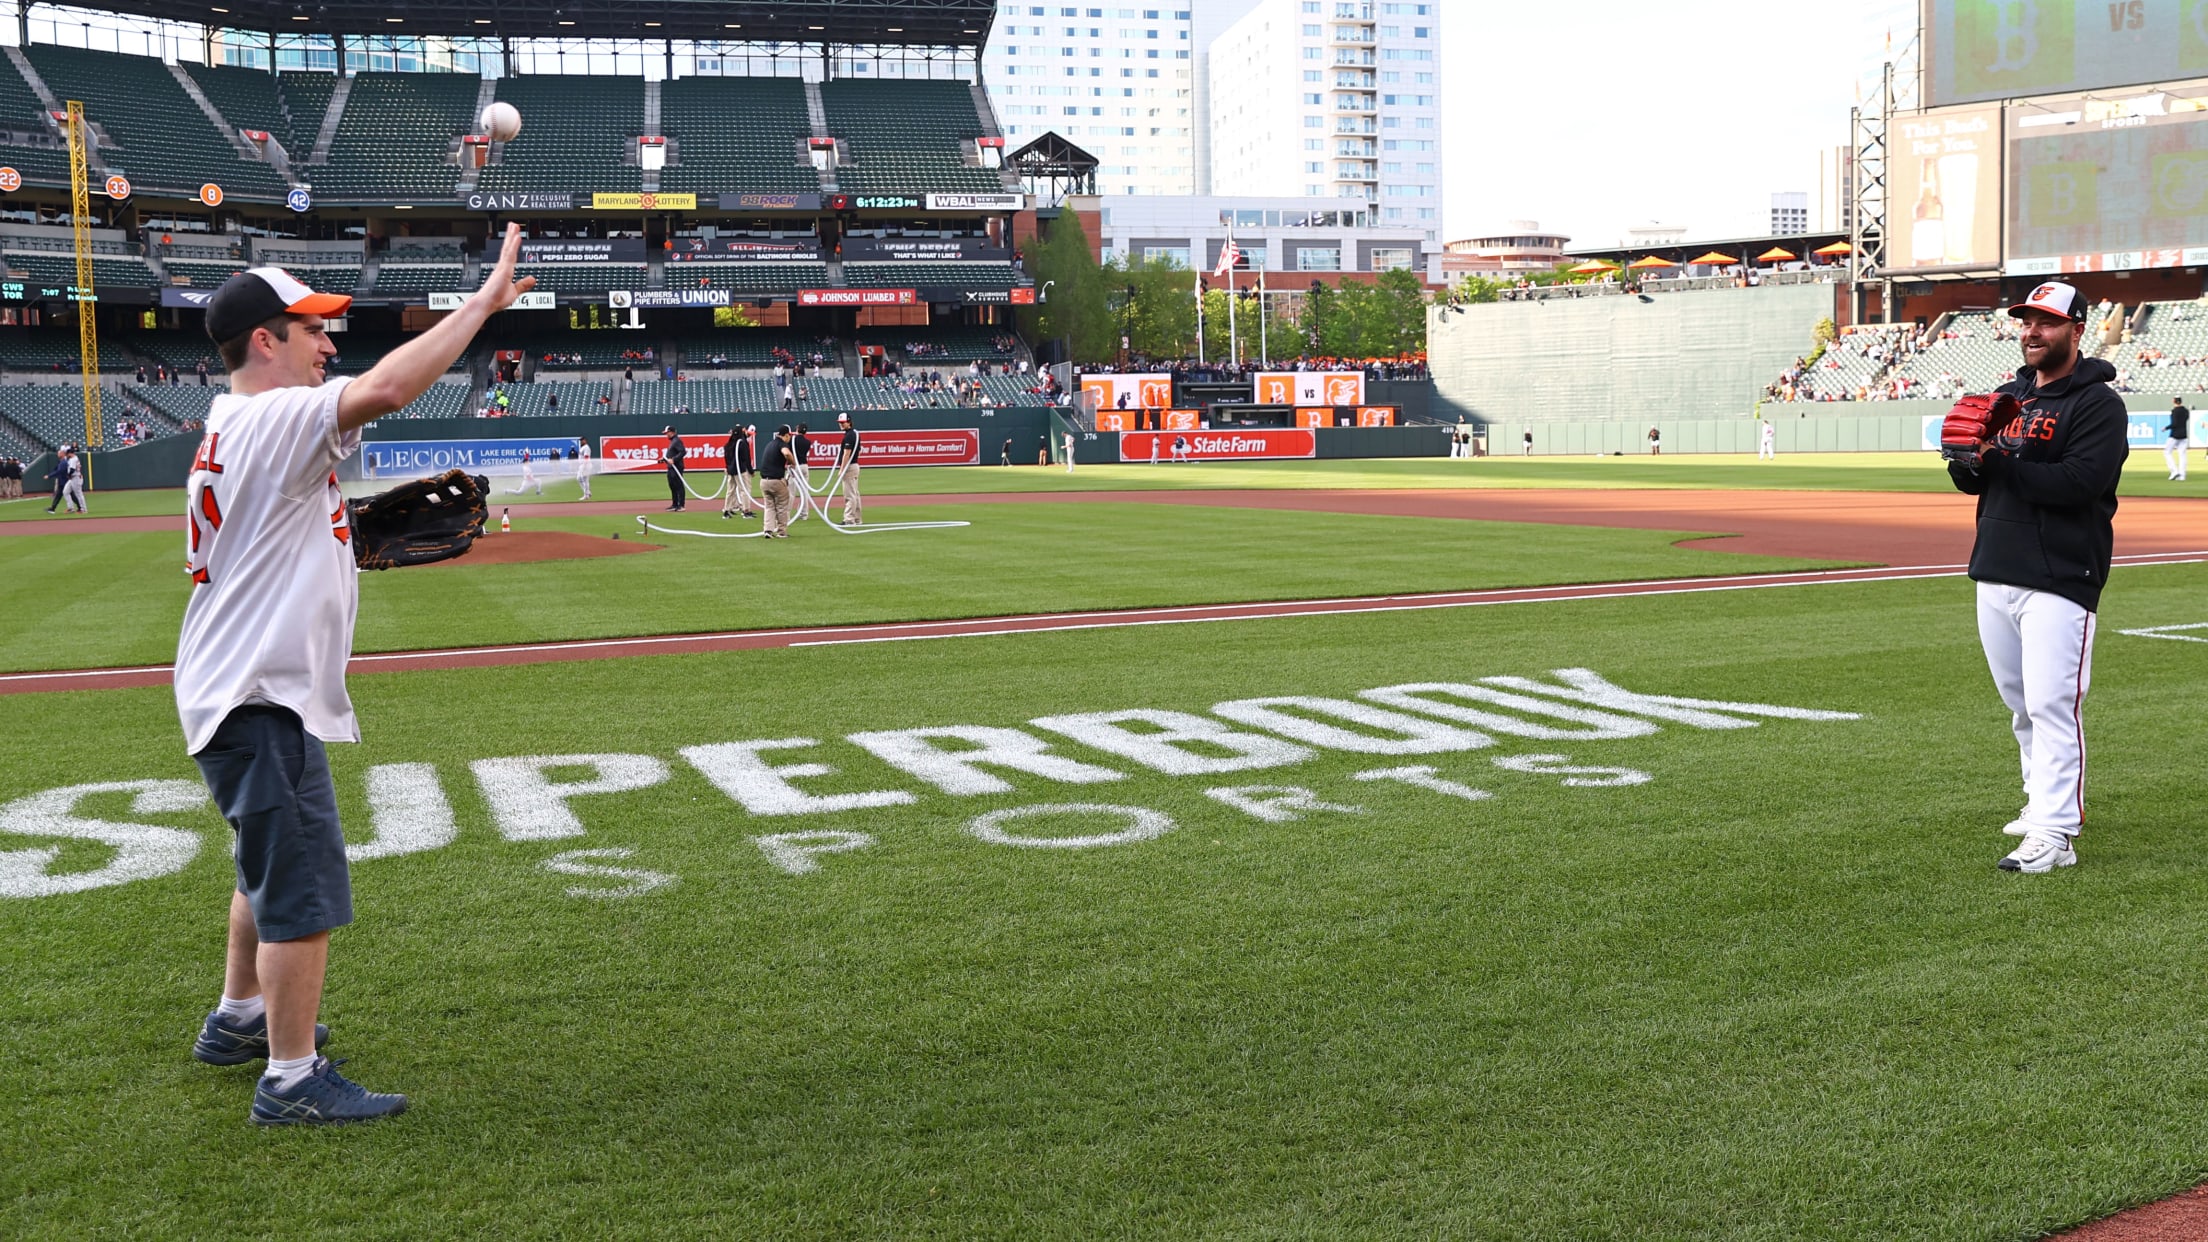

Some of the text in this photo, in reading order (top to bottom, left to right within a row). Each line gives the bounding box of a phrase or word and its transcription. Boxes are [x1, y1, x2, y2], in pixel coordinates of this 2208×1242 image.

[2108, 0, 2144, 32] VS
[2101, 115, 2147, 128] SPORTS
[1903, 117, 1988, 138] This Bud's
[1911, 140, 1940, 155] For
[0, 172, 17, 186] 22
[110, 182, 127, 194] 33
[207, 189, 216, 201] 8
[291, 195, 307, 206] 42
[468, 195, 529, 209] GANZ
[531, 201, 547, 209] REAL
[598, 197, 639, 205] MARYLAND
[657, 197, 691, 205] LOTTERY
[856, 197, 918, 208] 6:12:23 PM
[936, 197, 975, 206] WBAL
[2113, 252, 2132, 269] VS
[2, 283, 24, 291] CWS
[41, 288, 60, 296] 7:07
[2, 291, 23, 300] TOR
[432, 297, 450, 305] DRINK
[536, 296, 553, 304] LOCAL
[682, 290, 730, 304] UNION
[821, 293, 896, 302] JOHNSON LUMBER
[1304, 389, 1315, 399] VS
[981, 409, 994, 417] 398
[1441, 426, 1455, 434] 410
[1083, 433, 1098, 441] 376
[480, 449, 499, 457] LAKE
[501, 448, 517, 456] ERIE
[612, 444, 659, 459] weis
[871, 445, 887, 453] Best
[888, 444, 906, 453] Value
[916, 444, 935, 452] Home
[936, 443, 963, 452] Comfort
[541, 752, 1653, 904] SPORTS
